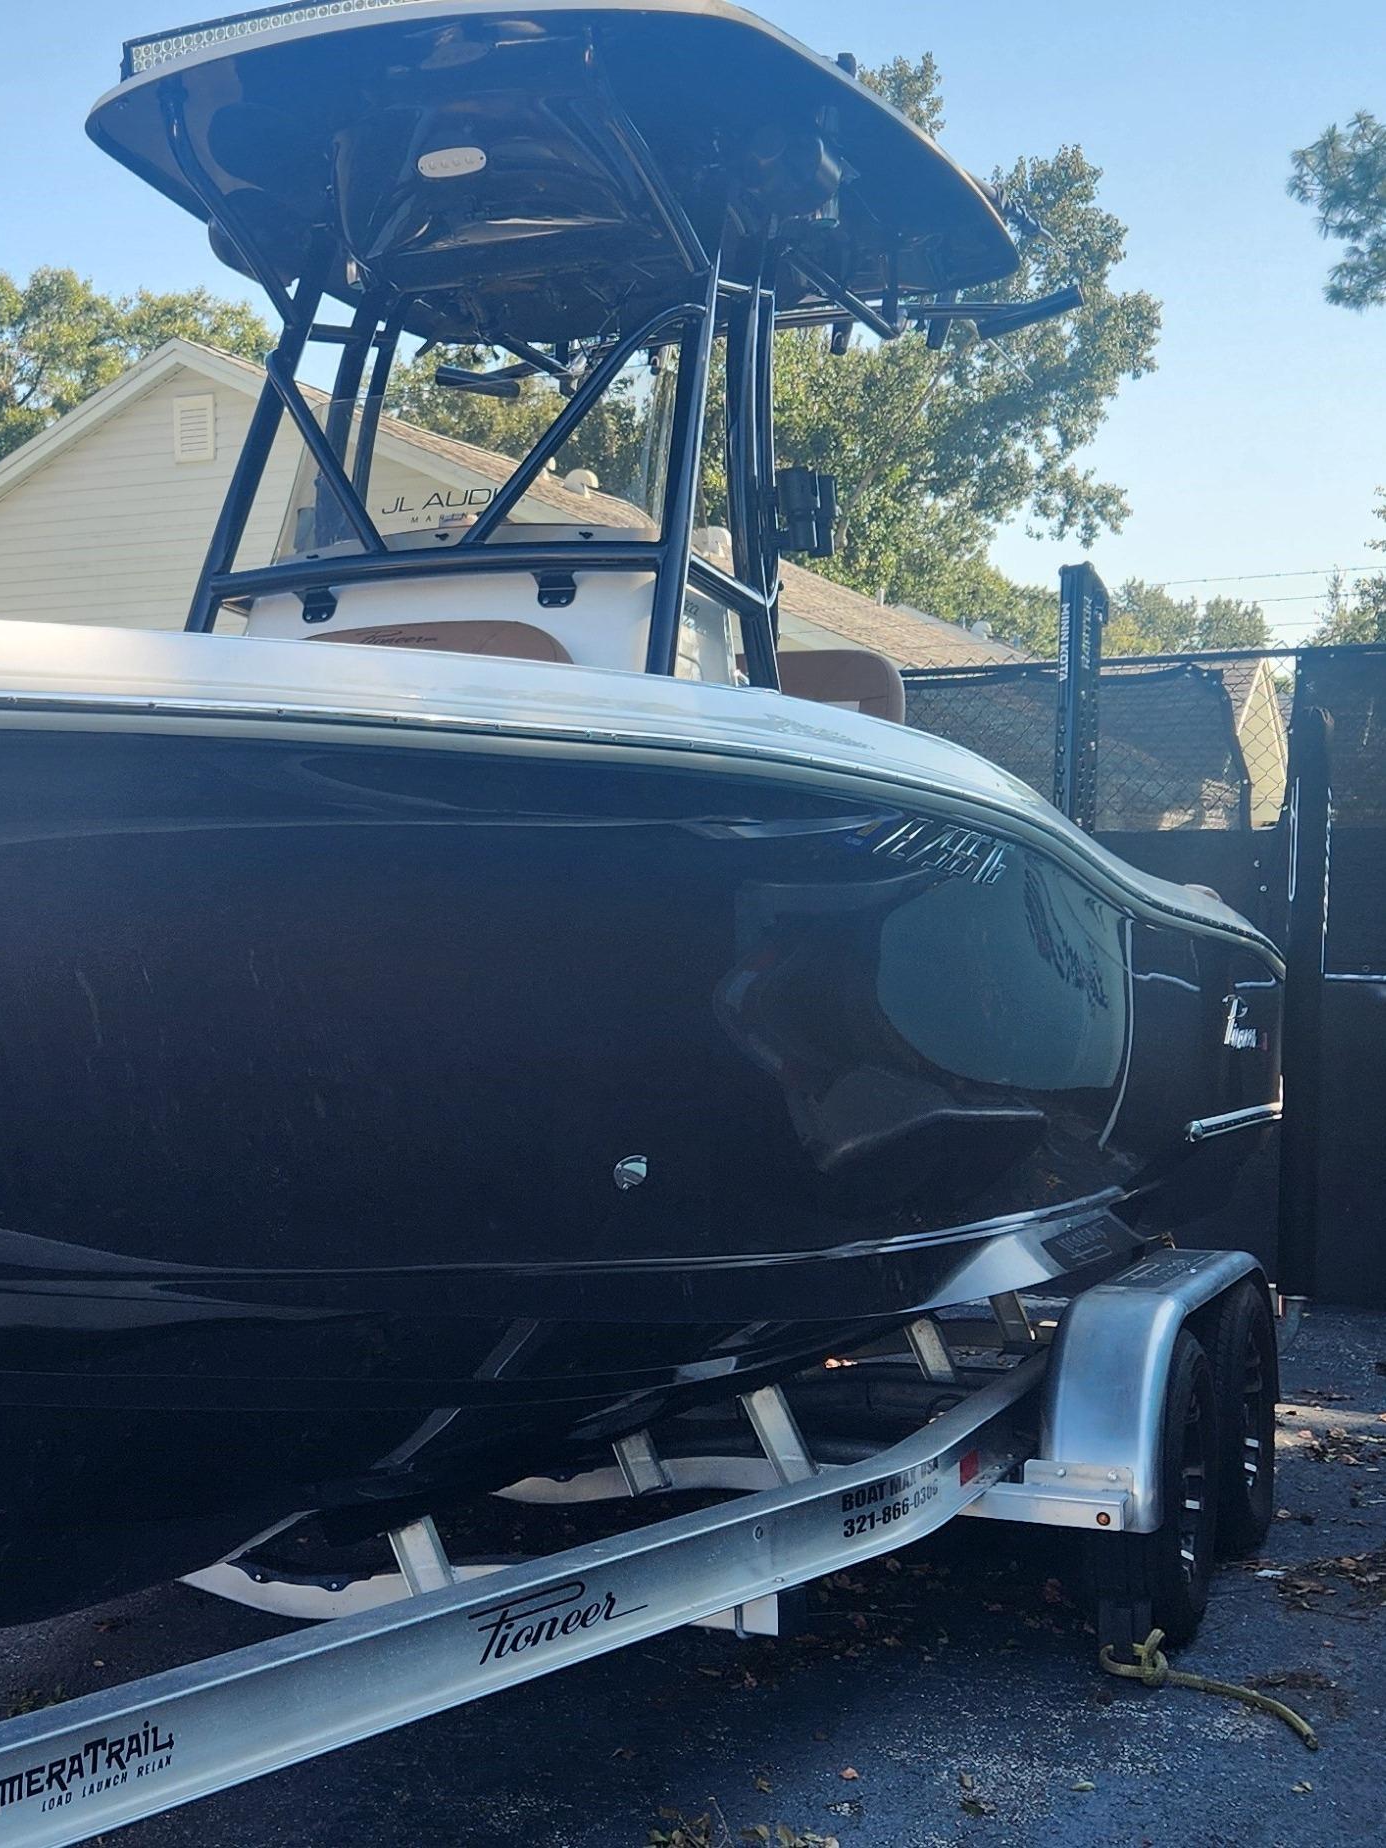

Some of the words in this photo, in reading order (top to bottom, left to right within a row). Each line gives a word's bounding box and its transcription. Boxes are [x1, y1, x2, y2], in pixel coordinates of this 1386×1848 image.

[381, 496, 415, 515] JL
[422, 487, 499, 511] AUDI
[1060, 602, 1071, 643] MINN
[1059, 644, 1070, 682] KOTA
[841, 1482, 887, 1513] BOAT
[468, 1580, 648, 1666] Pioneer
[41, 1791, 73, 1813] LOAD
[81, 1771, 128, 1798] LAUNCH
[136, 1754, 172, 1778] RELAX
